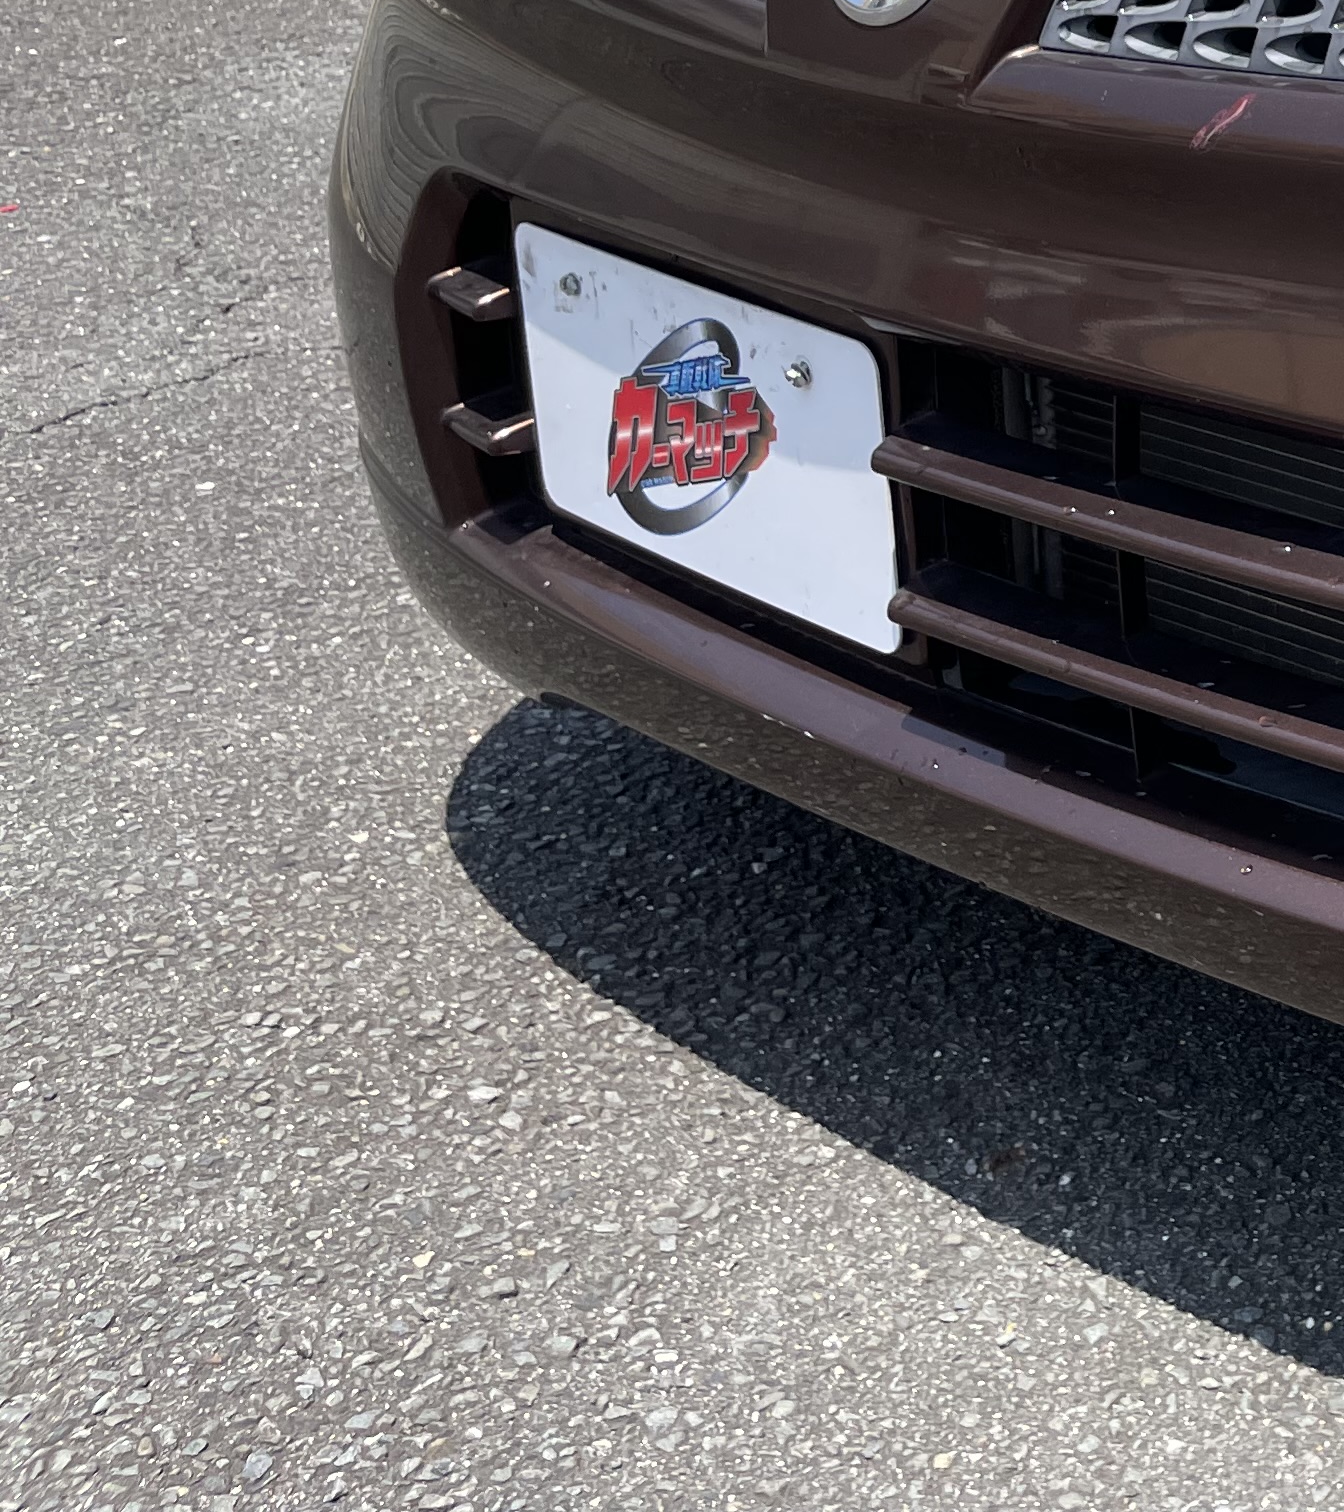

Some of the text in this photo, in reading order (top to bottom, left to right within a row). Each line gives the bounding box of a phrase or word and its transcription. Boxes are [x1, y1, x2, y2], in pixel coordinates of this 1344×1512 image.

[607, 377, 761, 496] カーマッチ
